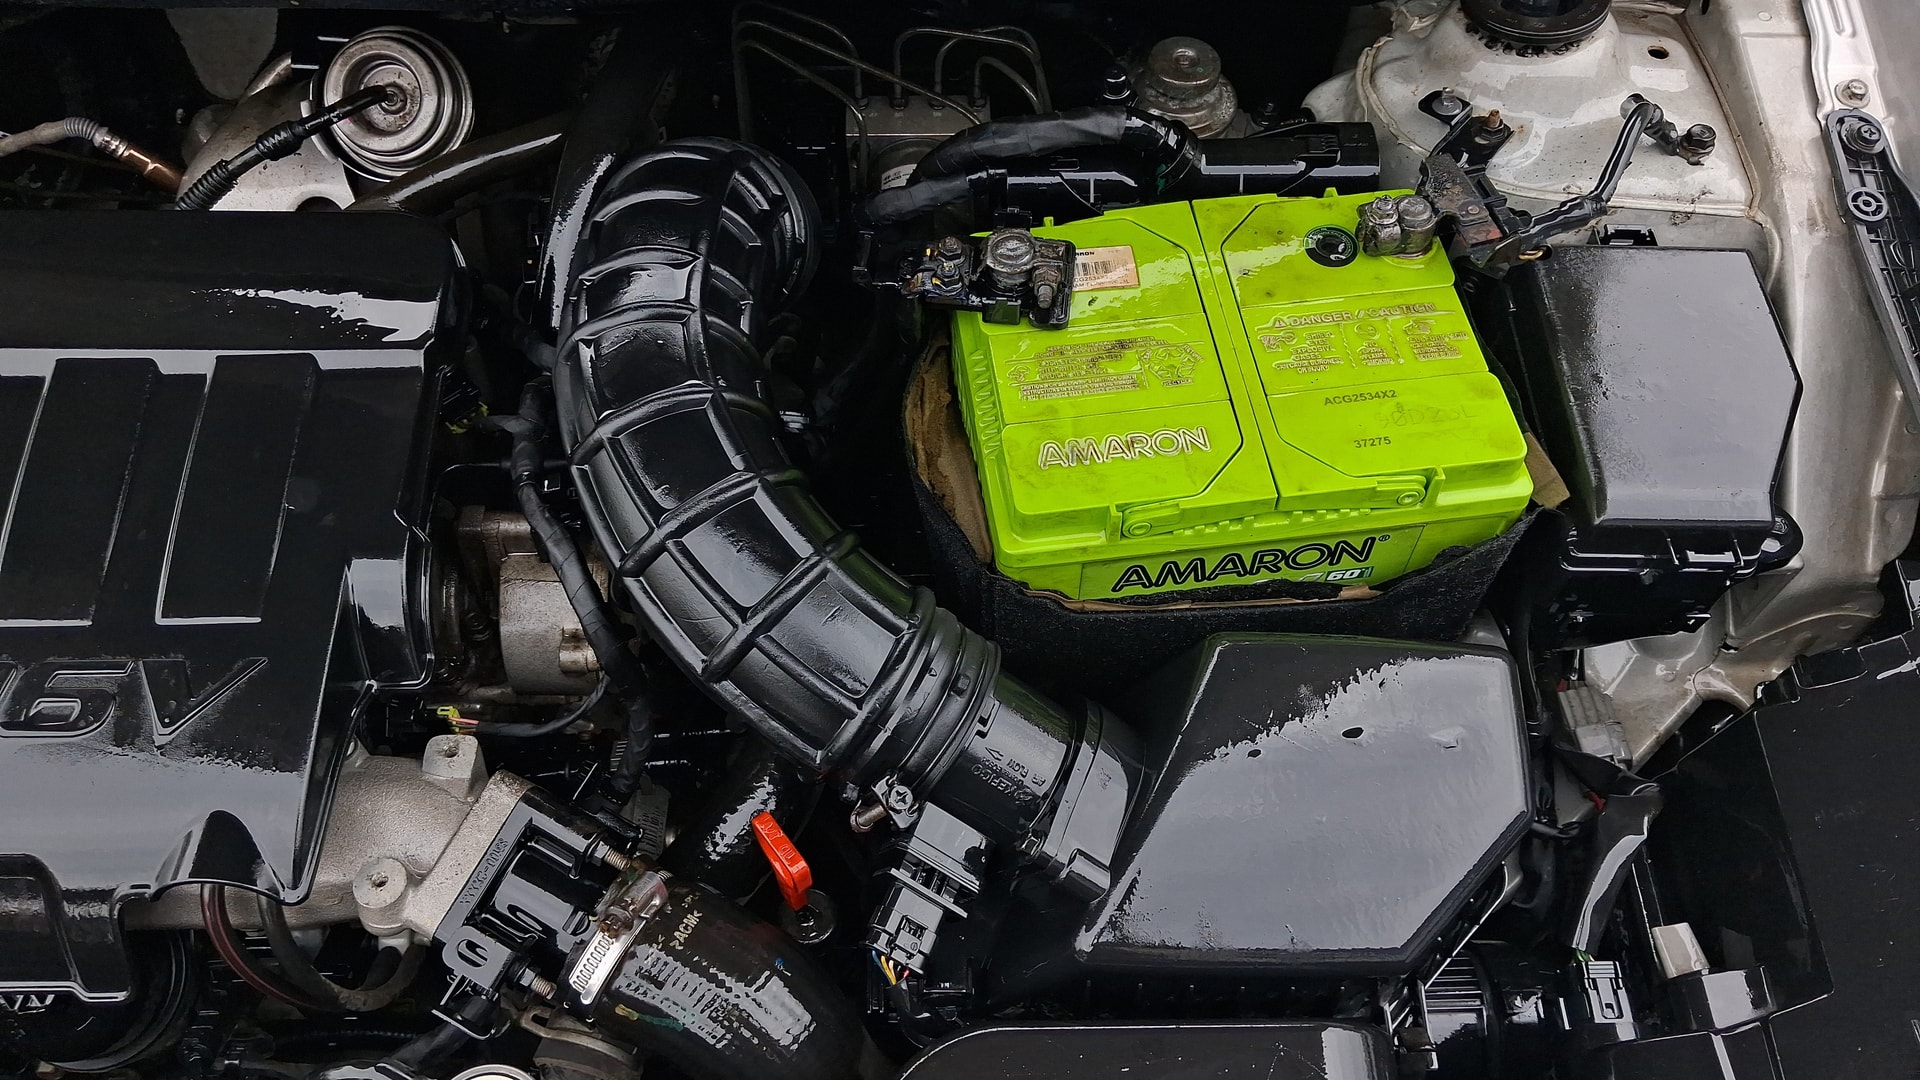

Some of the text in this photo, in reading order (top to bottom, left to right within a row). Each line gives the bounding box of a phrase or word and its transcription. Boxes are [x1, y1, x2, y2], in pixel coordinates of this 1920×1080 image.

[1290, 311, 1352, 326] DANGER
[1367, 303, 1436, 318] CAUTION
[1324, 389, 1398, 407] ACG2534X2
[1038, 425, 1212, 471] AMARON
[1354, 436, 1392, 449] 37275
[1110, 535, 1377, 593] AMARON
